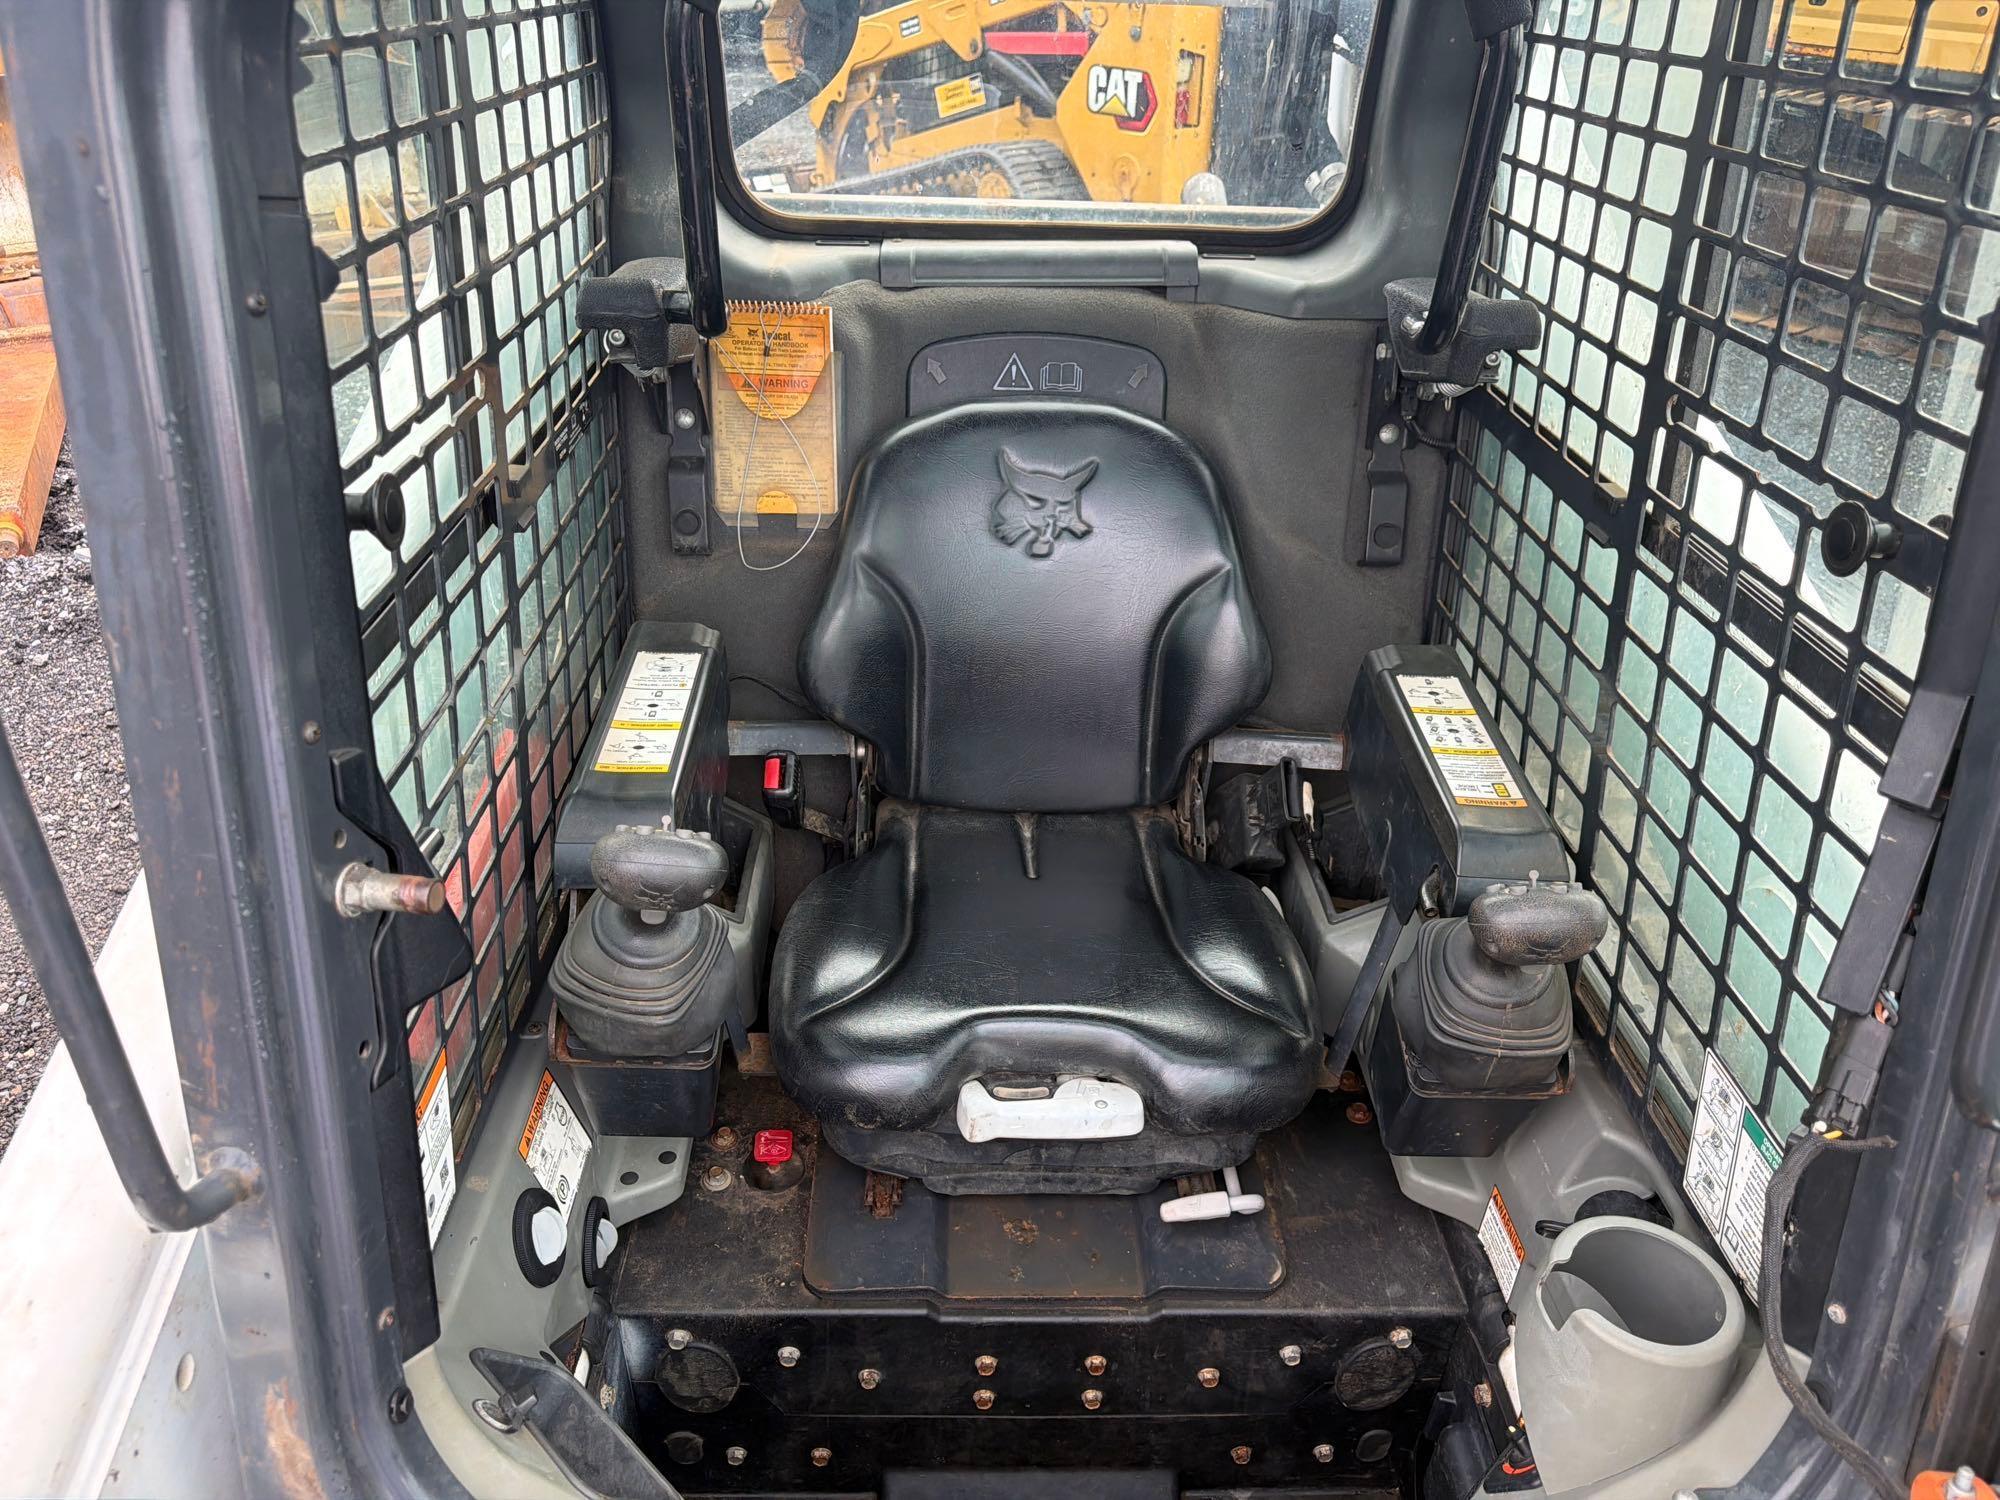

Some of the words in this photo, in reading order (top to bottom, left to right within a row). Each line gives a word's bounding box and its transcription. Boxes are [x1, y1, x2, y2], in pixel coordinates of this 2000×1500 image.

[1088, 64, 1143, 118] CAT
[773, 340, 809, 348] HANDBOOK
[759, 378, 809, 389] WARNING
[527, 1080, 549, 1134] WARNING
